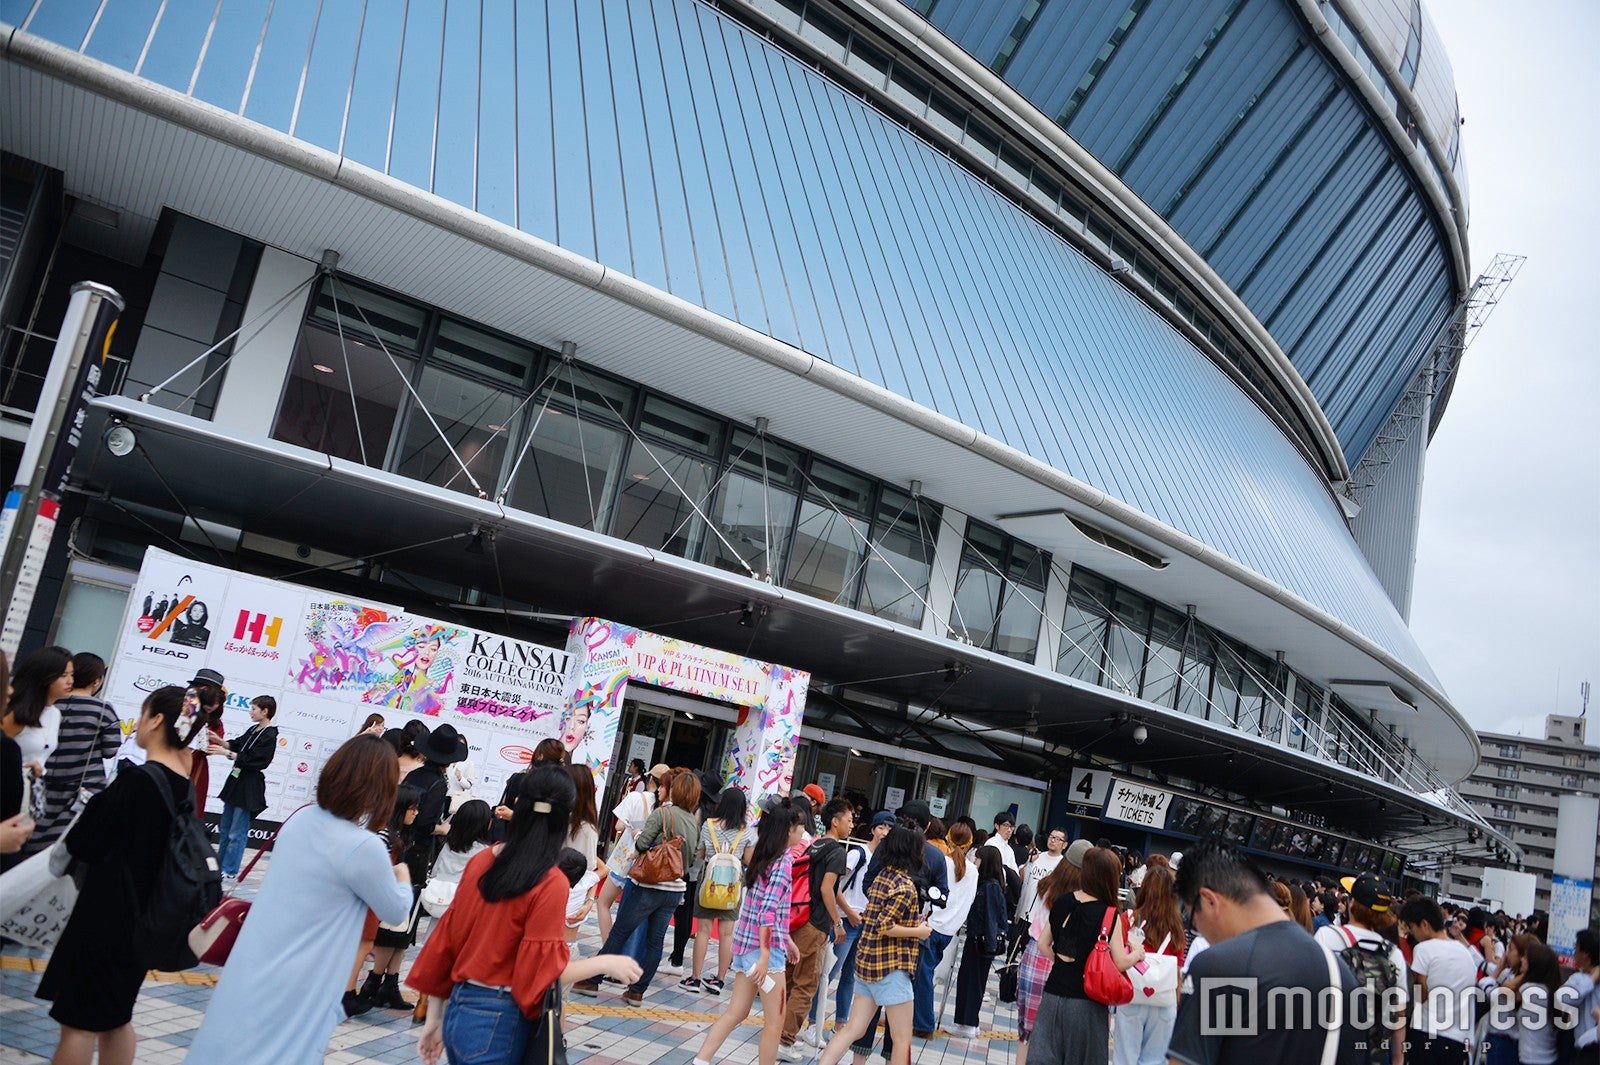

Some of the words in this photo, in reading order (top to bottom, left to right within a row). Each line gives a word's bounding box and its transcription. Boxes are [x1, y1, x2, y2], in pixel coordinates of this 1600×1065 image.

[141, 644, 189, 660] HEAD
[224, 641, 279, 661] ほっかほっか亭
[470, 633, 570, 675] KANSAI
[590, 648, 620, 663] KANSAI
[463, 667, 482, 677] 2016
[466, 654, 566, 687] COLLECTION
[583, 656, 628, 674] COLLECTION
[636, 652, 656, 671] VIP
[658, 660, 667, 674] &
[670, 660, 730, 689] PLATINUM
[731, 676, 760, 695] SEAT
[460, 683, 522, 705] 東日本大震災
[457, 696, 538, 721] 復興プロジェクト
[1076, 772, 1093, 799] 4
[1120, 805, 1155, 824] TICKETS
